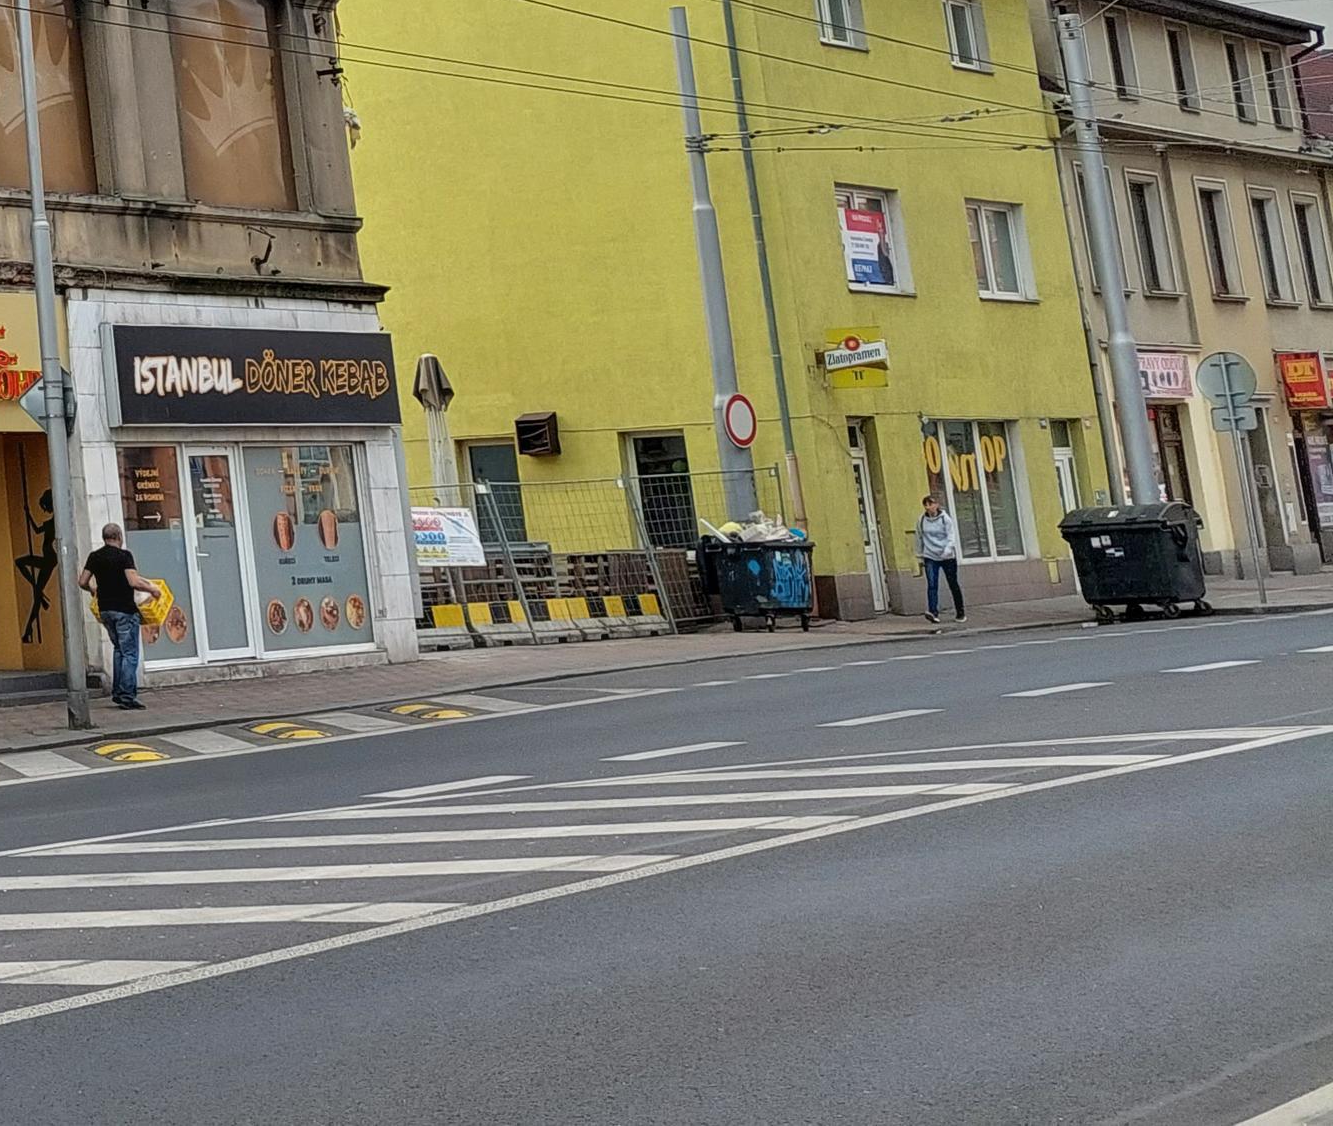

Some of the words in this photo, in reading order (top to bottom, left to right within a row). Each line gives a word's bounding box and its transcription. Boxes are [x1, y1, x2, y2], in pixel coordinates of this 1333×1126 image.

[827, 345, 881, 366] Zlatopramen
[133, 355, 244, 398] ISTANBUL
[244, 348, 320, 399] DÖNER
[319, 358, 390, 400] KEBAB
